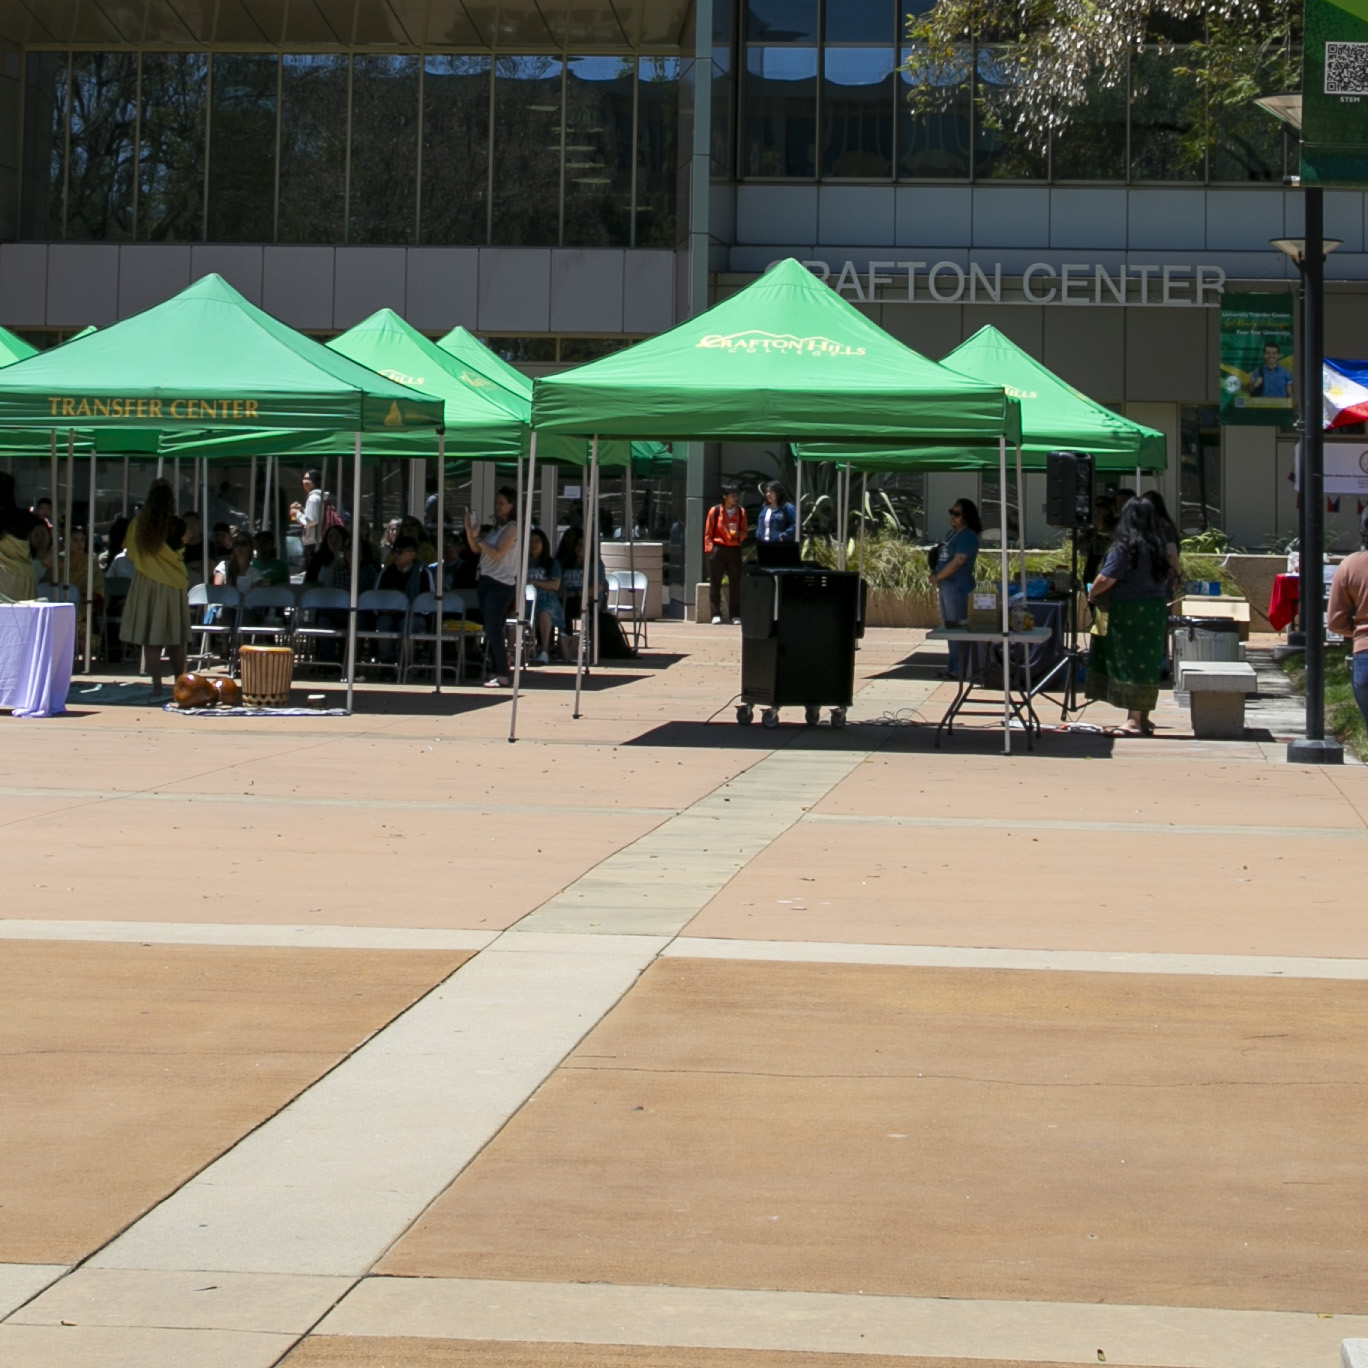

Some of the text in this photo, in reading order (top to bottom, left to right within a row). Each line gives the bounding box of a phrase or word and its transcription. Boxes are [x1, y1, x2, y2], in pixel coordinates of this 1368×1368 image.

[765, 259, 1226, 306] AFTON CENTER
[695, 334, 867, 356] CRAFTON HILLS
[728, 347, 838, 358] COLLEGE
[47, 397, 260, 419] TRANSFER CENTER
